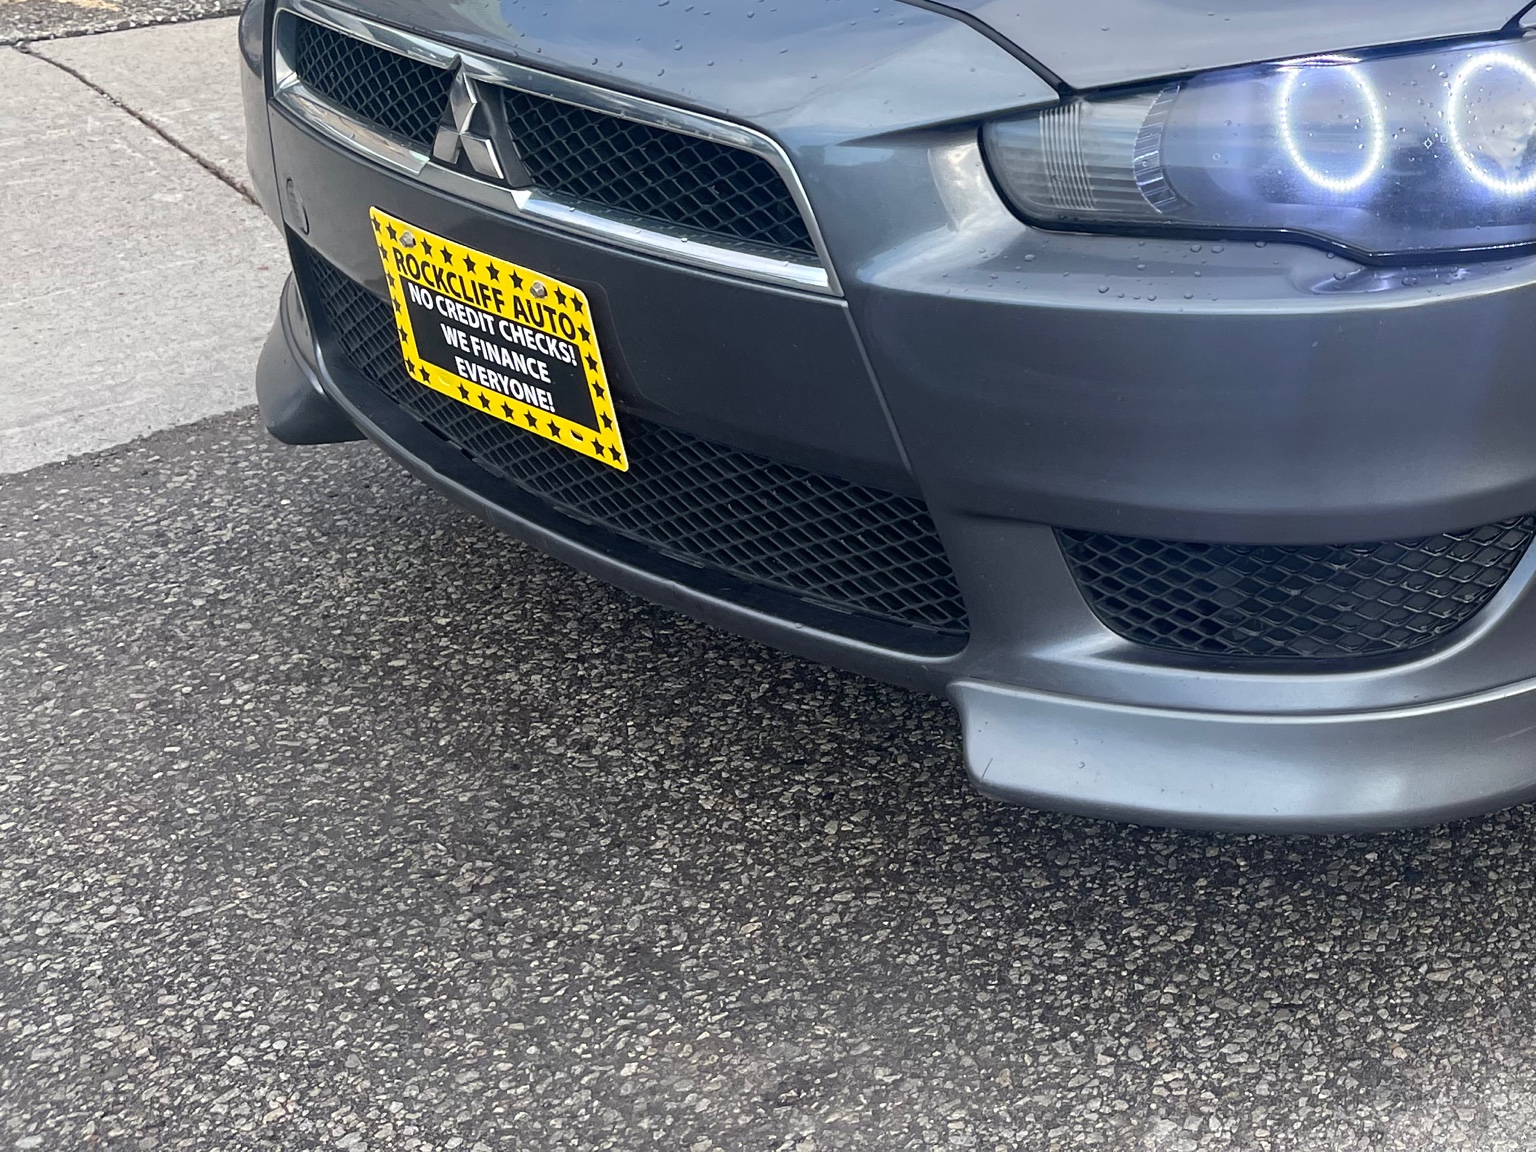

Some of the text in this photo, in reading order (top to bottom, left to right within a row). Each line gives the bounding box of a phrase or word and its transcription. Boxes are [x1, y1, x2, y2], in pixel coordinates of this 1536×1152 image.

[392, 247, 577, 340] ROCKCLIFF AUTO
[408, 282, 578, 367] NO CREDIT CHECKS!
[440, 323, 552, 384] WE FINANCE
[454, 356, 556, 413] EVERYONE!
